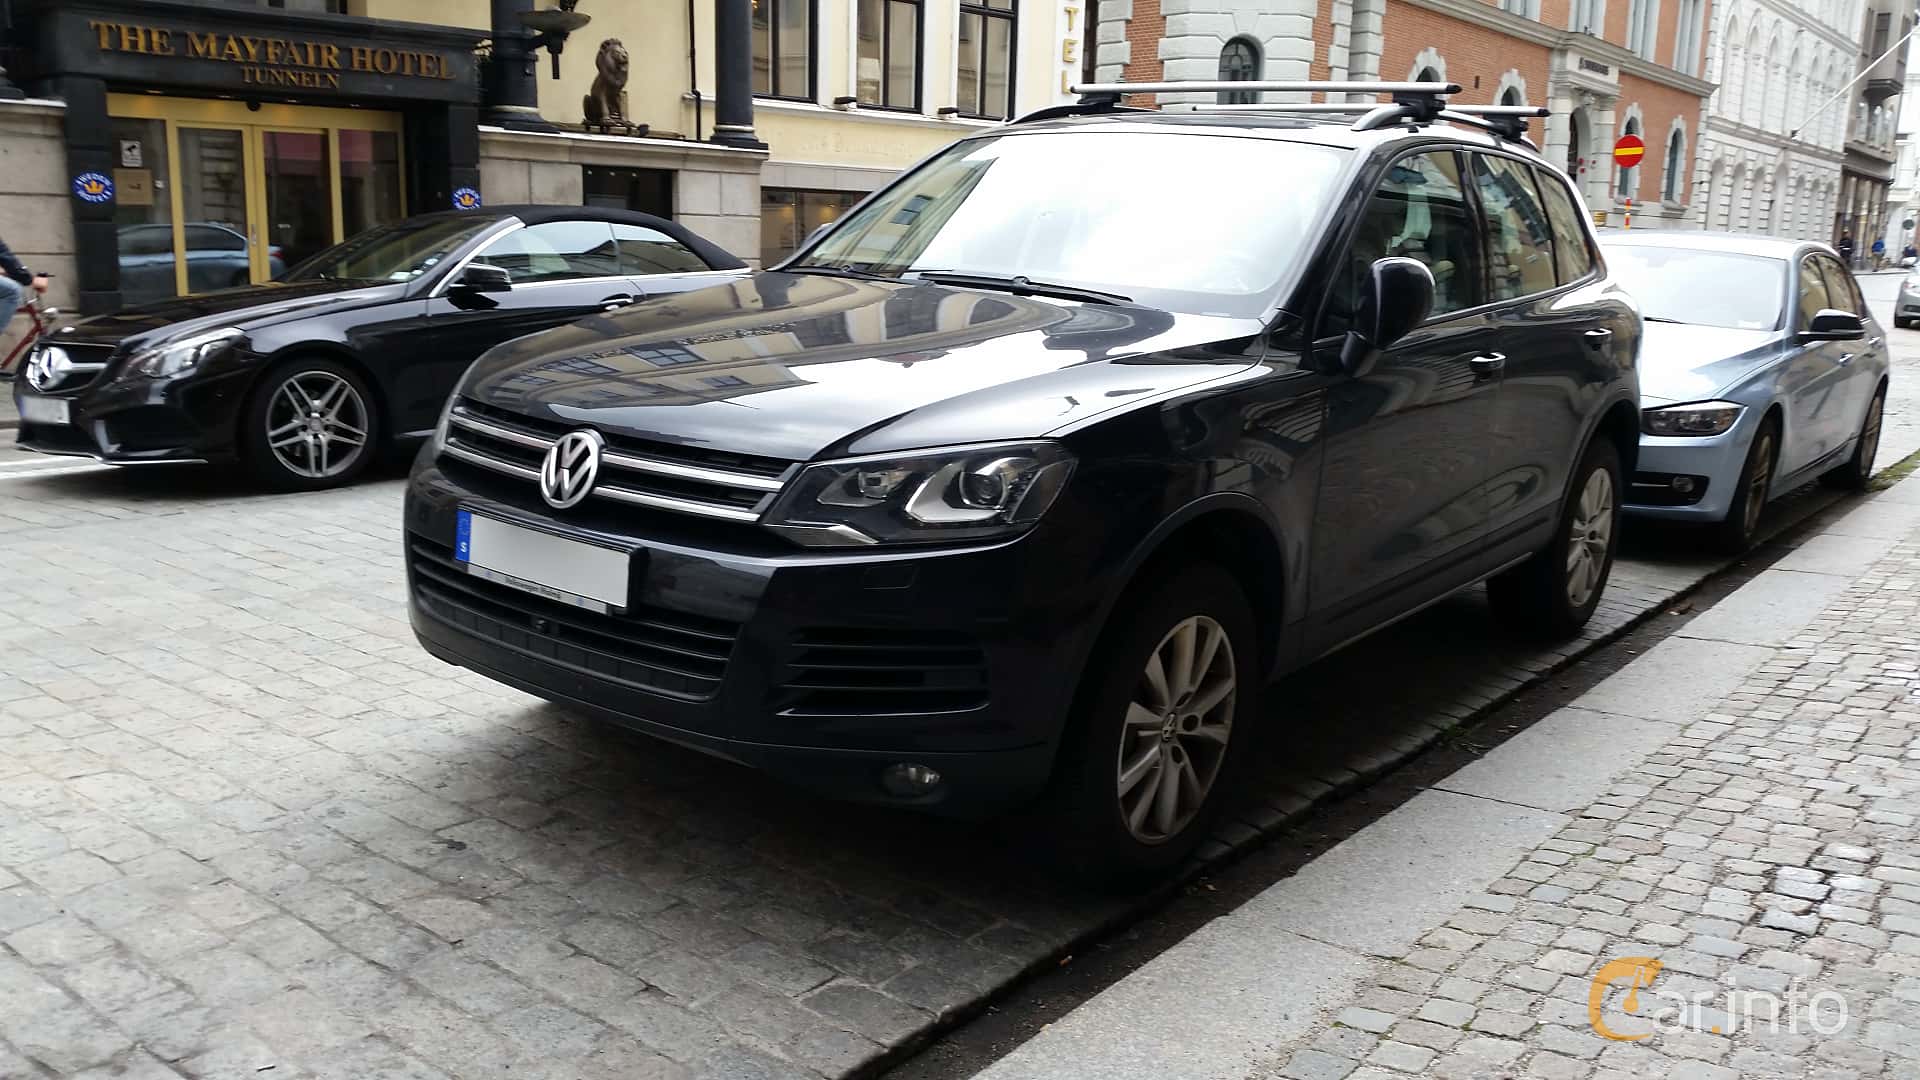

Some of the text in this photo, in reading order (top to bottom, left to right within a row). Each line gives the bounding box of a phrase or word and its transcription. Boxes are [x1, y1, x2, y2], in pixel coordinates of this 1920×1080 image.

[89, 20, 457, 80] THE MAYFAIR HOTEL
[241, 66, 340, 88] TUNNELN
[460, 541, 468, 553] S
